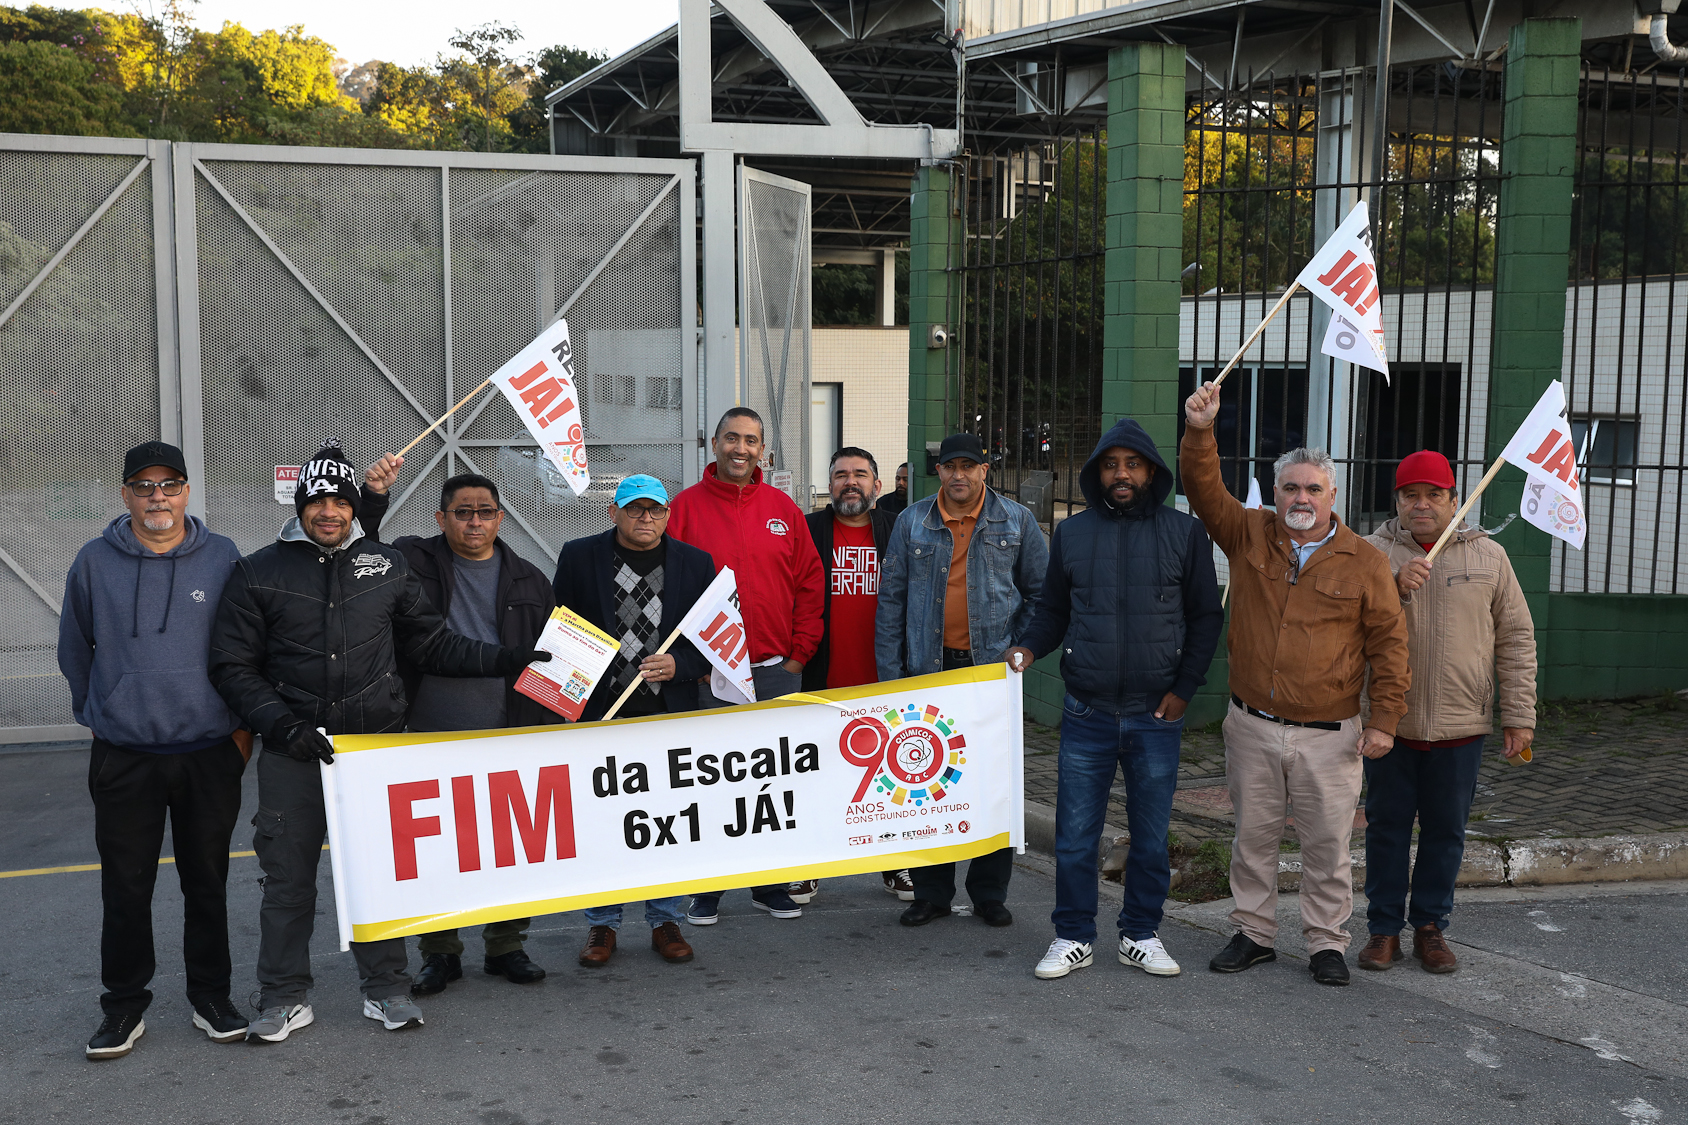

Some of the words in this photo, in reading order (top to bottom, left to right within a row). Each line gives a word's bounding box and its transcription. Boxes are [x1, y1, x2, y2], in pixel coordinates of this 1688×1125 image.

[1317, 249, 1380, 316] JÁ!
[551, 340, 577, 388] RE
[508, 360, 575, 429] JÁ!
[278, 470, 298, 478] ATE
[305, 477, 338, 497] LA
[698, 610, 748, 670] JÁ!
[870, 705, 889, 713] AOS
[895, 729, 934, 745] QUÍMICOS
[387, 764, 577, 881] FIM
[592, 755, 650, 798] da
[667, 736, 820, 789] Escala
[623, 803, 700, 850] 6x1
[723, 783, 797, 838] JÁ!
[845, 809, 917, 825] CONSTRUINDO
[920, 808, 928, 816] O
[930, 803, 970, 815] FUTURO
[846, 802, 885, 816] ANOS
